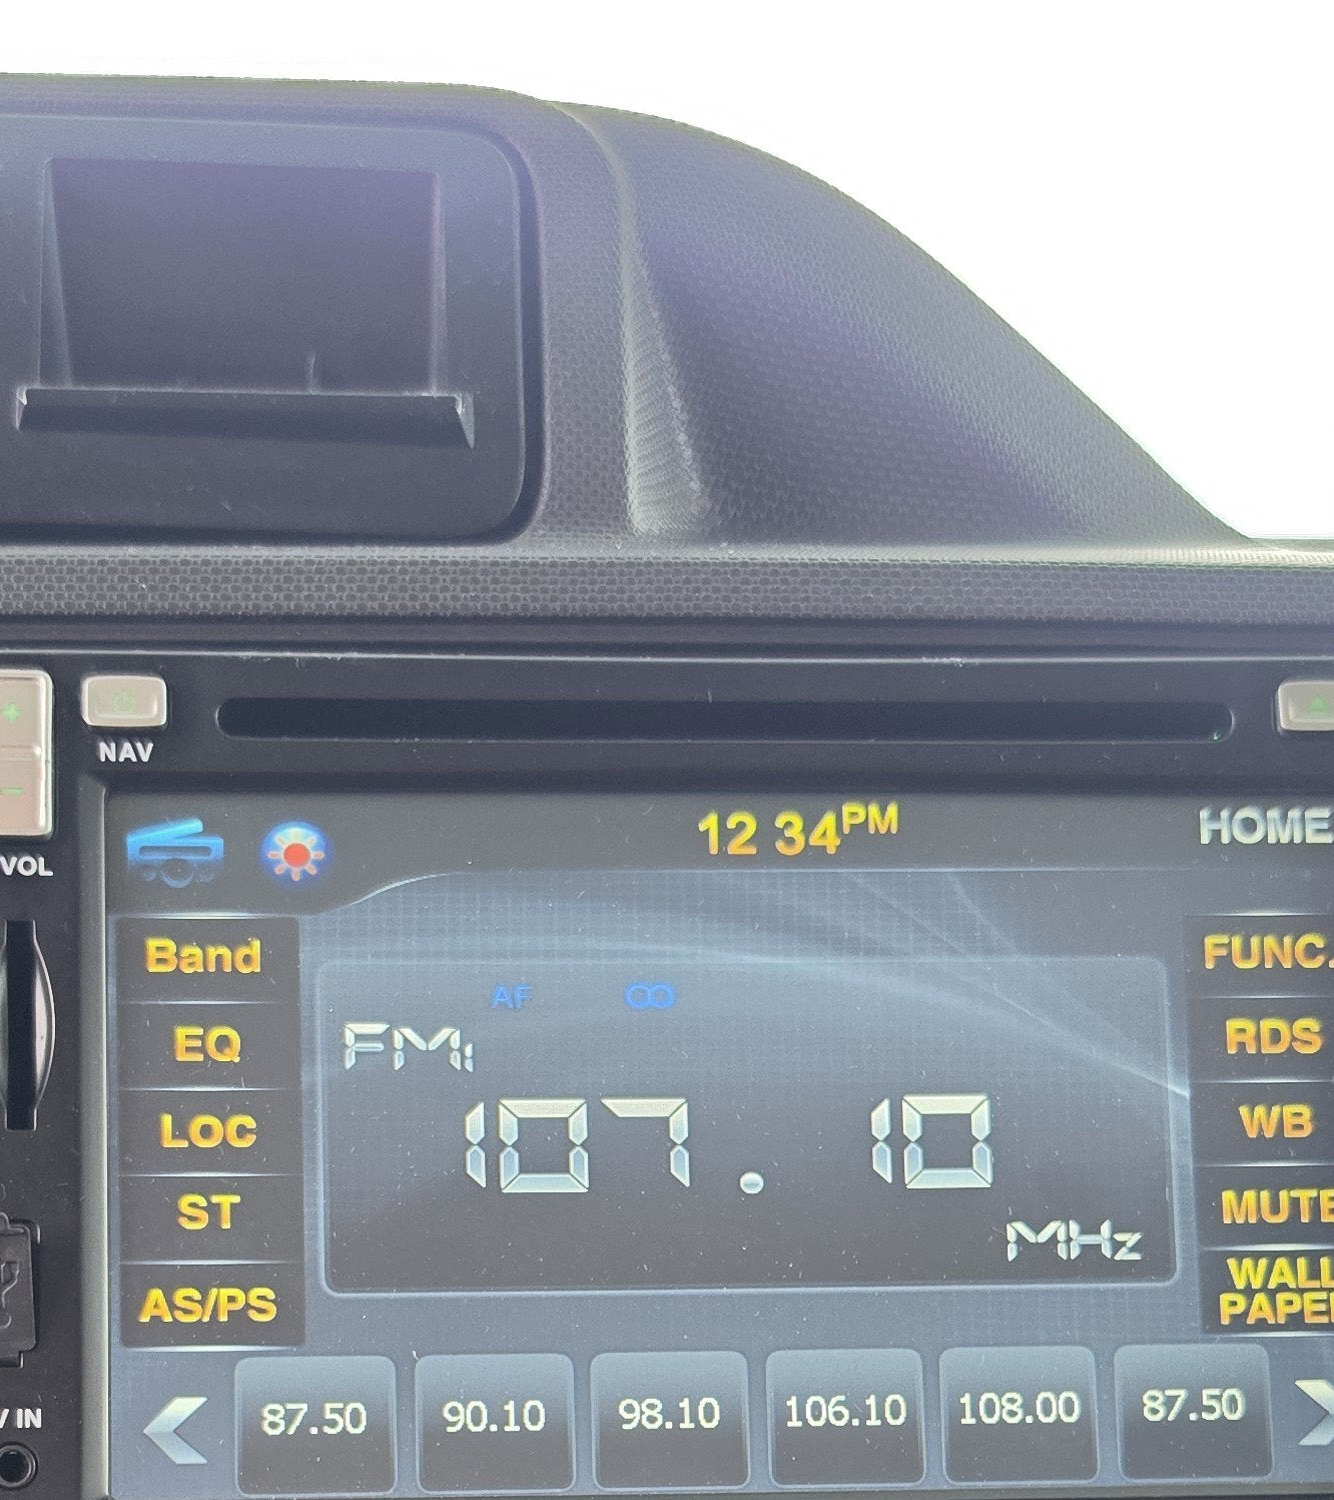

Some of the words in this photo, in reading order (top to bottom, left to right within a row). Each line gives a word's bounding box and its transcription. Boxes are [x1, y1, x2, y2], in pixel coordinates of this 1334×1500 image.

[99, 740, 154, 762] NAV
[1200, 807, 1334, 845] HOME
[0, 856, 53, 877] VOL
[145, 938, 261, 974] Band
[490, 982, 533, 1009] AF
[174, 1027, 241, 1063] EQ
[1226, 1019, 1323, 1055] RDS
[161, 1115, 258, 1149] LOC
[1239, 1105, 1314, 1138] WB
[178, 1195, 240, 1230] ST
[1006, 1219, 1142, 1262] MHz
[138, 1288, 277, 1323] AS/PS
[16, 1408, 42, 1429] IN
[261, 1403, 368, 1436] 87.50
[442, 1400, 546, 1433] 90.10
[619, 1397, 721, 1430] 98.10
[785, 1395, 907, 1428] 106.10
[959, 1392, 1081, 1424] 108.00
[1142, 1389, 1244, 1422] 87.50
